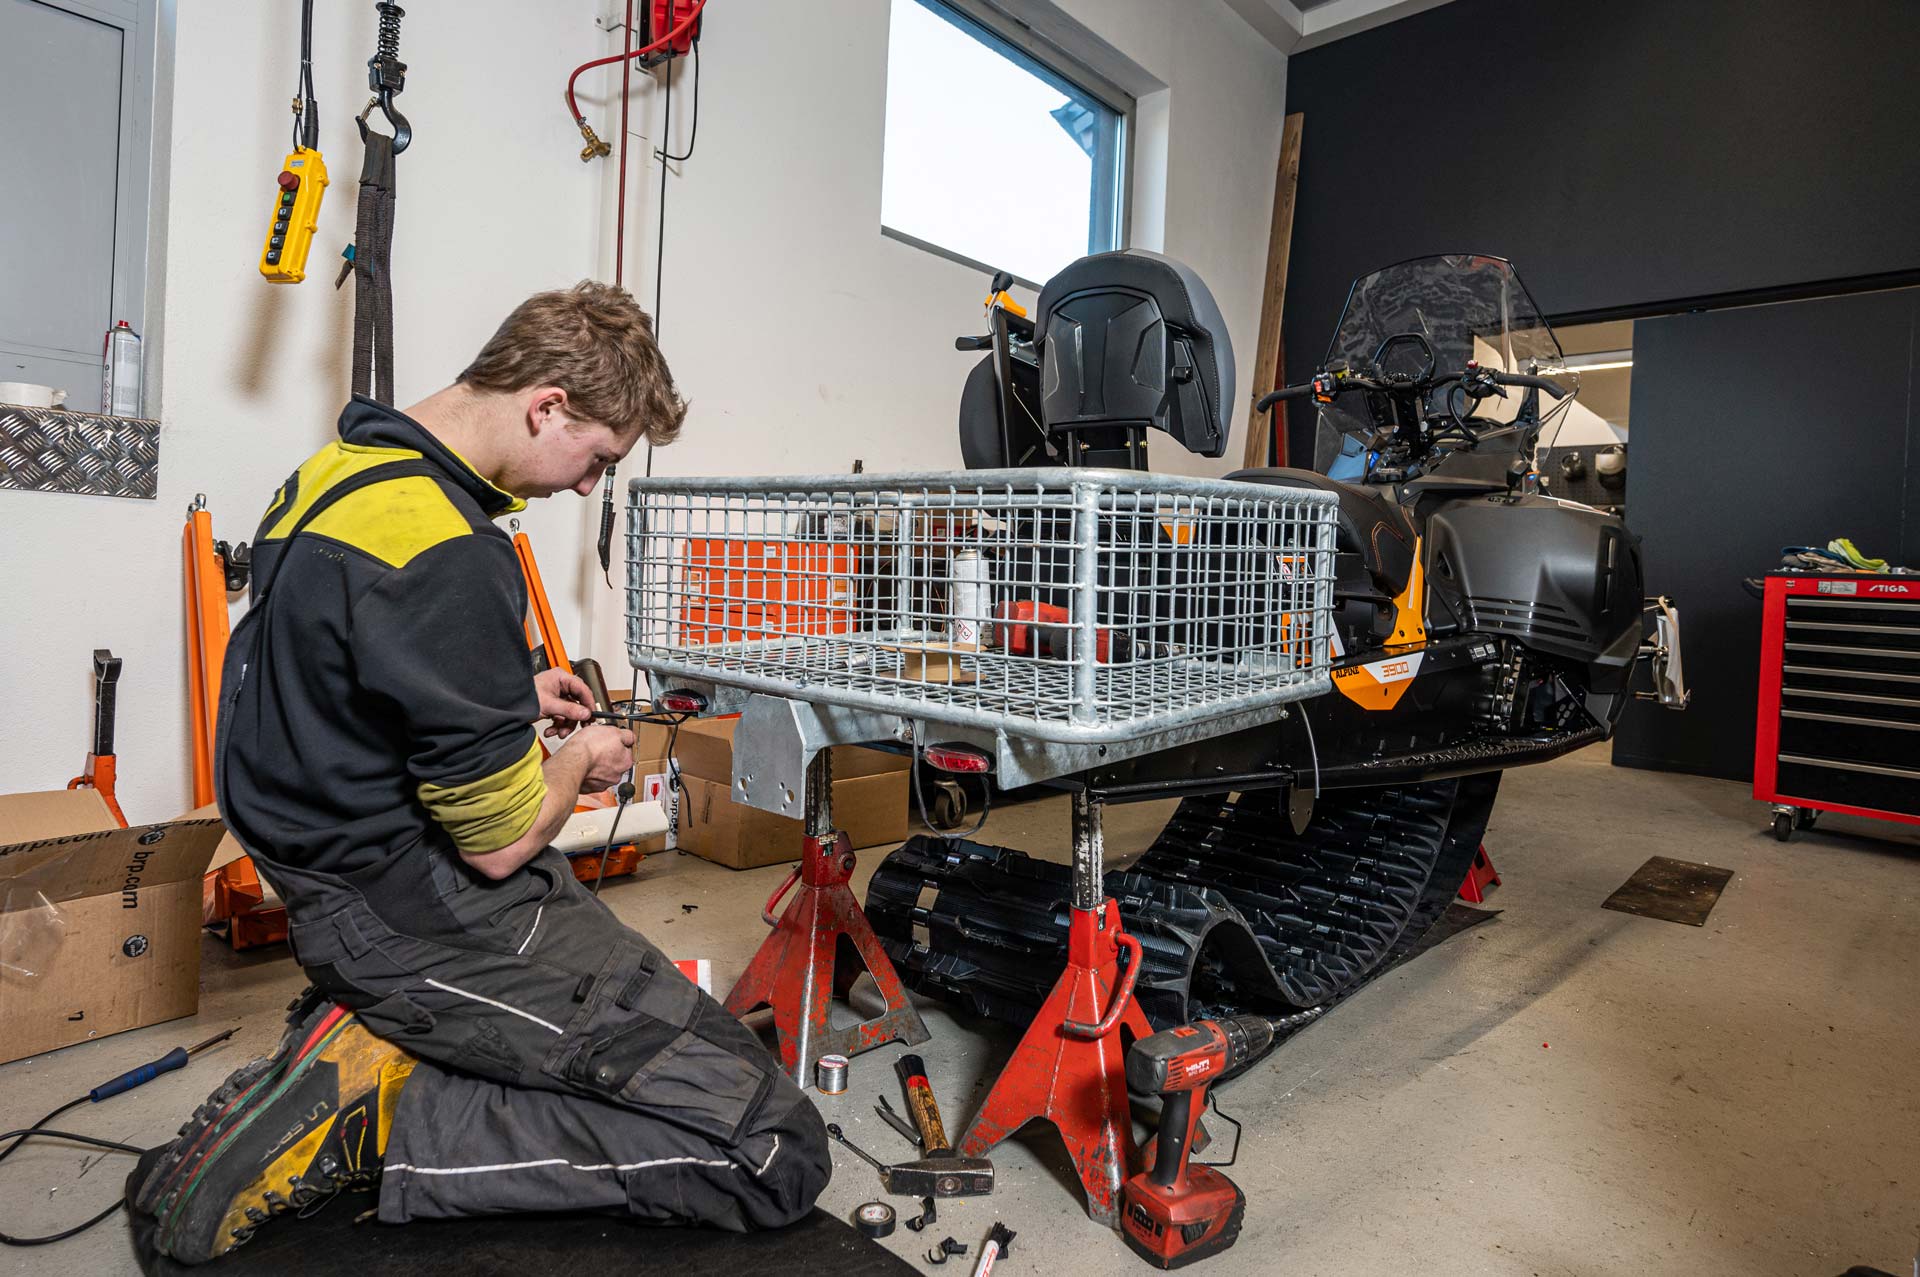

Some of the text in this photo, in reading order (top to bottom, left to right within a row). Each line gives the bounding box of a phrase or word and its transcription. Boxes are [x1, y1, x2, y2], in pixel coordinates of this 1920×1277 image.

[1869, 584, 1909, 593] STIGA
[1336, 661, 1410, 679] ALPINE 3900
[122, 851, 155, 909] brp.com
